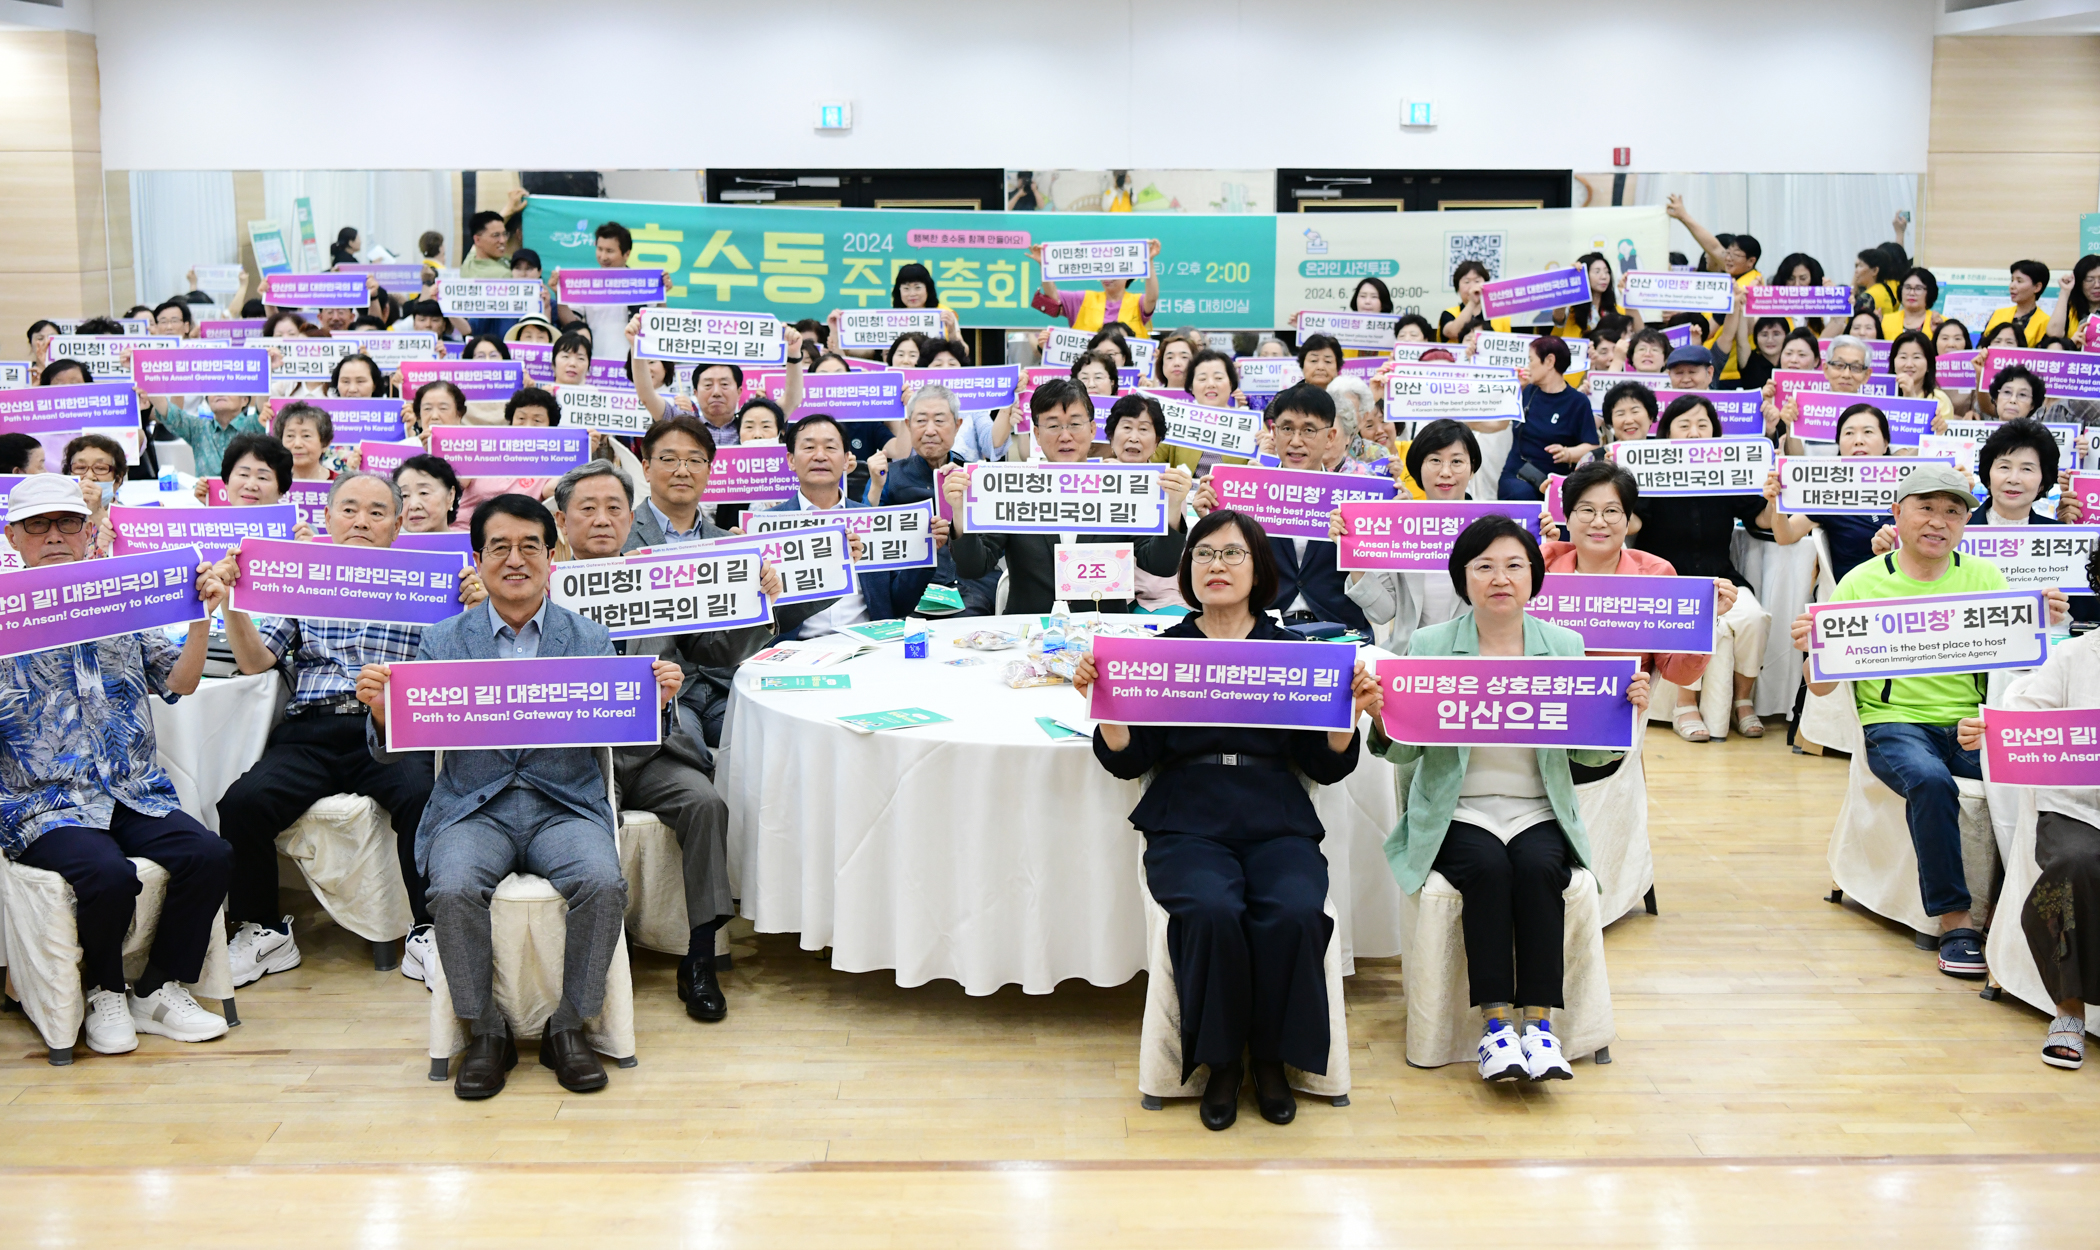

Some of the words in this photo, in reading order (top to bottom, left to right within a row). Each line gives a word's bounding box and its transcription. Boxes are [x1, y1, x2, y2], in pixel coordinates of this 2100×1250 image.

[843, 232, 893, 252] 2024
[1051, 247, 1087, 259] 이민청!
[1091, 246, 1123, 258] 안산의
[1128, 246, 1138, 256] 길
[627, 223, 829, 304] 호수동
[1058, 262, 1114, 274] 대한민국의
[1119, 261, 1132, 272] 길!
[1177, 261, 1200, 274] 오후
[1206, 262, 1249, 282] 2:00
[1306, 262, 1340, 275] 온라인
[1344, 261, 1390, 275] 사전투표
[444, 285, 481, 295] 이민청!
[485, 285, 518, 296] 안산의
[524, 285, 533, 296] 길
[839, 257, 1030, 309] 주총회
[452, 300, 508, 311] 대한민국의
[513, 301, 527, 311] 길!
[1174, 298, 1195, 313] 5층
[1199, 299, 1249, 313] 대회의실
[650, 316, 701, 332] 이민청!
[707, 319, 753, 335] 안산의
[760, 321, 773, 336] 길
[847, 316, 883, 327] 이민청!
[887, 315, 919, 326] 안산의
[924, 315, 933, 326] 길
[658, 337, 737, 355] 대한민국의
[744, 342, 763, 357] 길!
[141, 361, 172, 372] 안산의
[176, 360, 188, 372] 길!
[191, 360, 243, 371] 대한민국의
[246, 360, 260, 371] 길!
[809, 387, 822, 398] 길!
[825, 385, 879, 397] 대한민국의
[882, 385, 896, 396] 길!
[1394, 382, 1421, 394] 안산
[440, 439, 477, 451] 안산의
[480, 439, 496, 451] 길!
[499, 439, 560, 451] 대한민국의
[564, 439, 579, 451] 길!
[503, 454, 539, 462] Gateway
[1626, 448, 1682, 465] 이민청!
[1688, 446, 1739, 463] 안산의
[1746, 445, 1761, 461] 길
[1635, 470, 1723, 488] 대한민국의
[1731, 469, 1752, 485] 길!
[1792, 466, 1853, 482] 이민청!
[983, 473, 1051, 492] 이민청!
[1059, 474, 1121, 493] 안산의
[1130, 474, 1148, 494] 길
[1222, 479, 1257, 498] 안산
[1803, 490, 1898, 506] 대한민국의
[996, 501, 1100, 522] 대한민국의
[1110, 503, 1136, 522] 길!
[119, 523, 163, 537] 안산의
[167, 522, 186, 536] 길!
[189, 522, 263, 537] 대한민국의
[267, 523, 286, 536] 길!
[1354, 517, 1392, 534] 안산
[2031, 538, 2094, 558] 최적지
[249, 559, 302, 578] 안산의
[308, 563, 331, 580] 길!
[336, 565, 424, 586] 대한민국의
[430, 572, 452, 588] 길!
[563, 568, 641, 597] 이민청!
[649, 562, 717, 589] 안산의
[727, 559, 747, 582] 길
[1077, 563, 1106, 578] 2조
[31, 587, 57, 609] 길!
[62, 570, 158, 604] 대한민국의
[163, 565, 187, 586] 길!
[6, 619, 19, 629] to
[22, 610, 66, 626] Ansan!
[70, 599, 126, 620] Gateway
[129, 597, 141, 608] to
[144, 588, 183, 604] Korea!
[707, 593, 735, 617] 길!
[1558, 595, 1580, 611] 길!
[1585, 596, 1671, 614] 대한민국의
[1677, 598, 1699, 614] 길!
[1548, 617, 1587, 627] Ansan!
[1589, 618, 1640, 630] Gateway
[1643, 620, 1654, 628] to
[1658, 619, 1694, 629] Korea!
[1823, 615, 1868, 638] 안산
[1964, 604, 2032, 629] 최적지
[1845, 643, 1886, 655] Ansan
[1890, 644, 1898, 652] is
[1900, 643, 1916, 651] the
[1918, 642, 1940, 650] best
[1942, 640, 1970, 650] place
[1984, 637, 2006, 645] host
[1861, 656, 1889, 664] Korean
[1890, 653, 1936, 663] Immigration
[1938, 651, 1966, 659] Service
[1968, 649, 1997, 658] Agency
[1108, 660, 1168, 681] 안산의
[1175, 663, 1200, 682] 길!
[1206, 664, 1306, 686] 대한민국의
[1313, 668, 1339, 687] 길!
[406, 686, 468, 706] 안산의
[474, 685, 500, 704] 길!
[507, 682, 608, 703] 대한민국의
[615, 681, 640, 700] 길!
[1112, 685, 1142, 697] Path
[1145, 687, 1158, 696] to
[1161, 687, 1207, 698] Ansan!
[1210, 689, 1269, 702] Gateway
[1272, 692, 1285, 700] to
[1289, 691, 1331, 701] Korea!
[1392, 675, 1478, 694] 이민청은
[1486, 676, 1617, 695] 상호문화도시
[413, 712, 443, 722] Path
[446, 712, 460, 721] to
[464, 710, 509, 721] Ansan!
[513, 708, 572, 722] Gateway
[576, 708, 589, 718] to
[593, 706, 635, 717] Korea!
[1437, 700, 1567, 730] 안산으로
[2000, 727, 2063, 746] 안산의
[2069, 726, 2096, 744] 길!
[2008, 752, 2039, 762] Path
[2042, 752, 2056, 762] to
